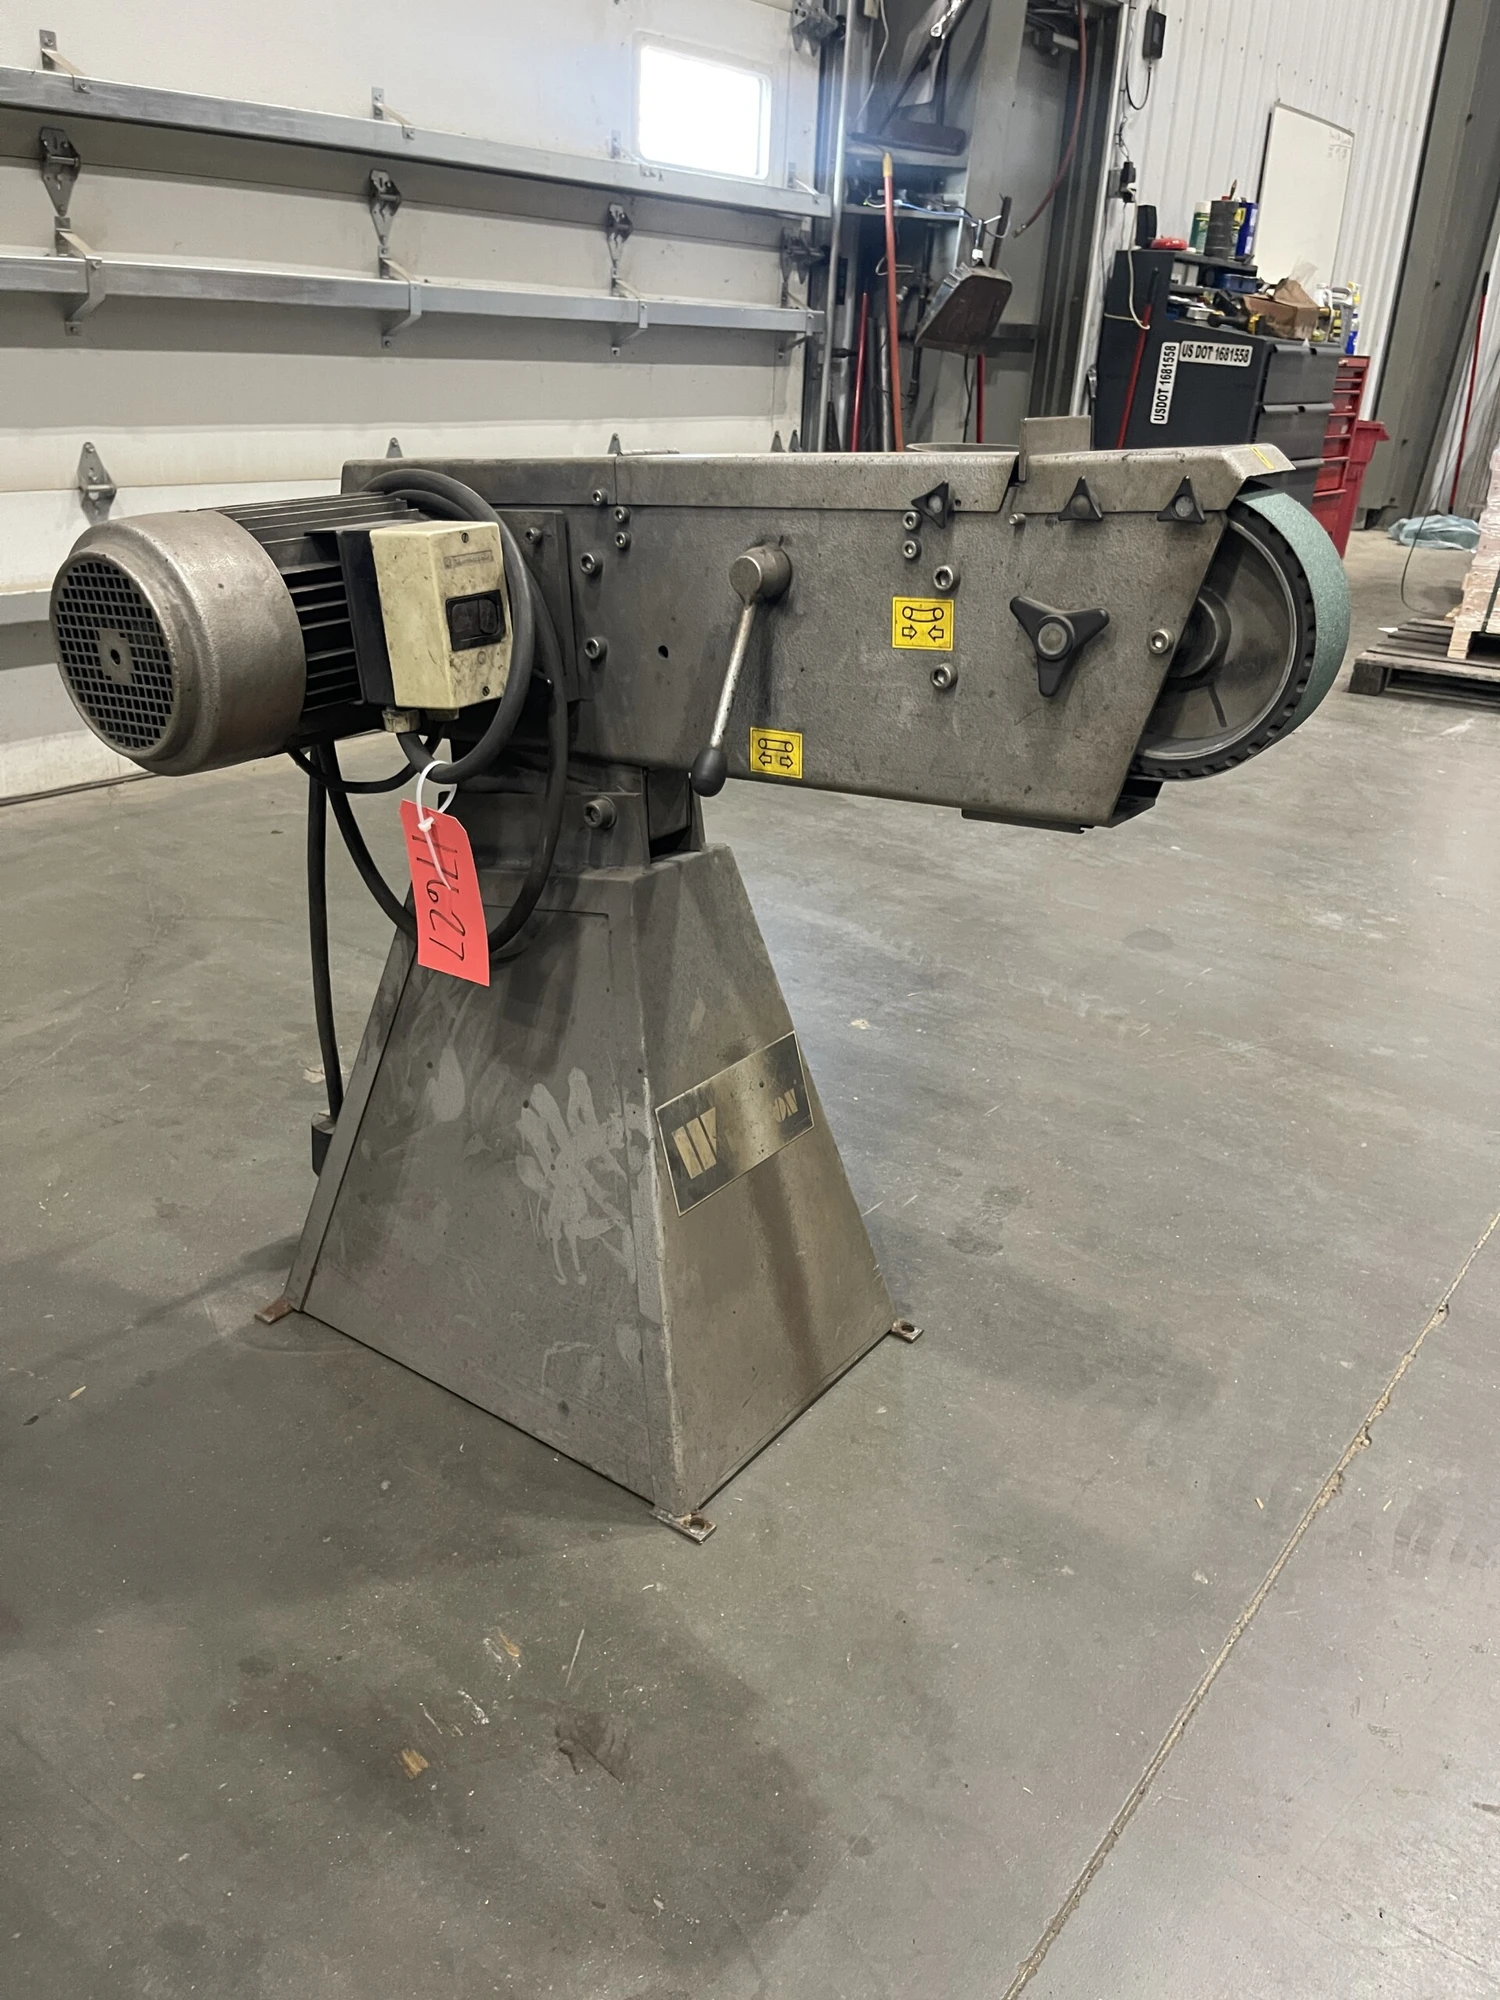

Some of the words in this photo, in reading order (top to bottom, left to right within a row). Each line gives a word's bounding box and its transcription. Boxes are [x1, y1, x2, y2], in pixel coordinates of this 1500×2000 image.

[1159, 345, 1177, 385] 1681558
[1181, 343, 1194, 358] US
[1195, 345, 1213, 360] DOT
[1215, 346, 1251, 363] 1681558
[1153, 388, 1169, 422] USDOT
